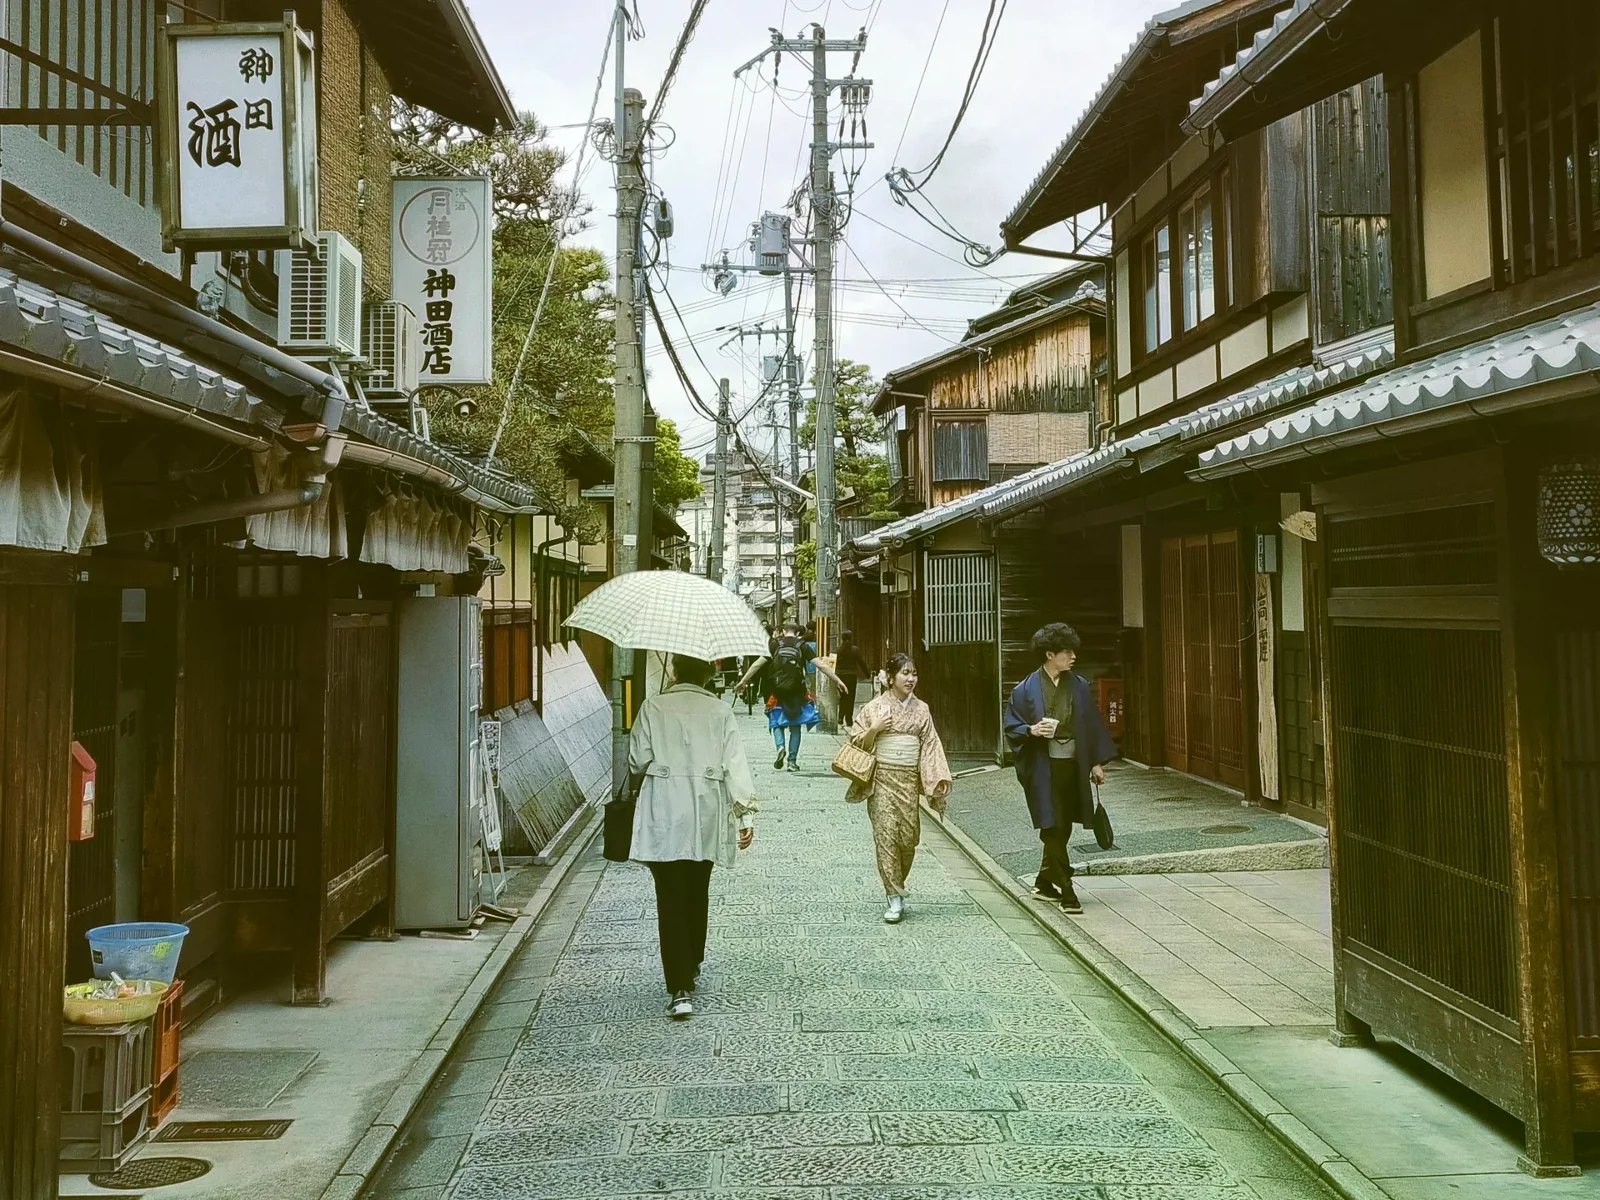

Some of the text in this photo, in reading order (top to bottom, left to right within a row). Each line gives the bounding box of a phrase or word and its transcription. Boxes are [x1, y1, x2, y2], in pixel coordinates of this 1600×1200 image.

[186, 98, 242, 168] 酒
[426, 191, 453, 263] 月桂冠
[419, 267, 456, 375] 神田酒店
